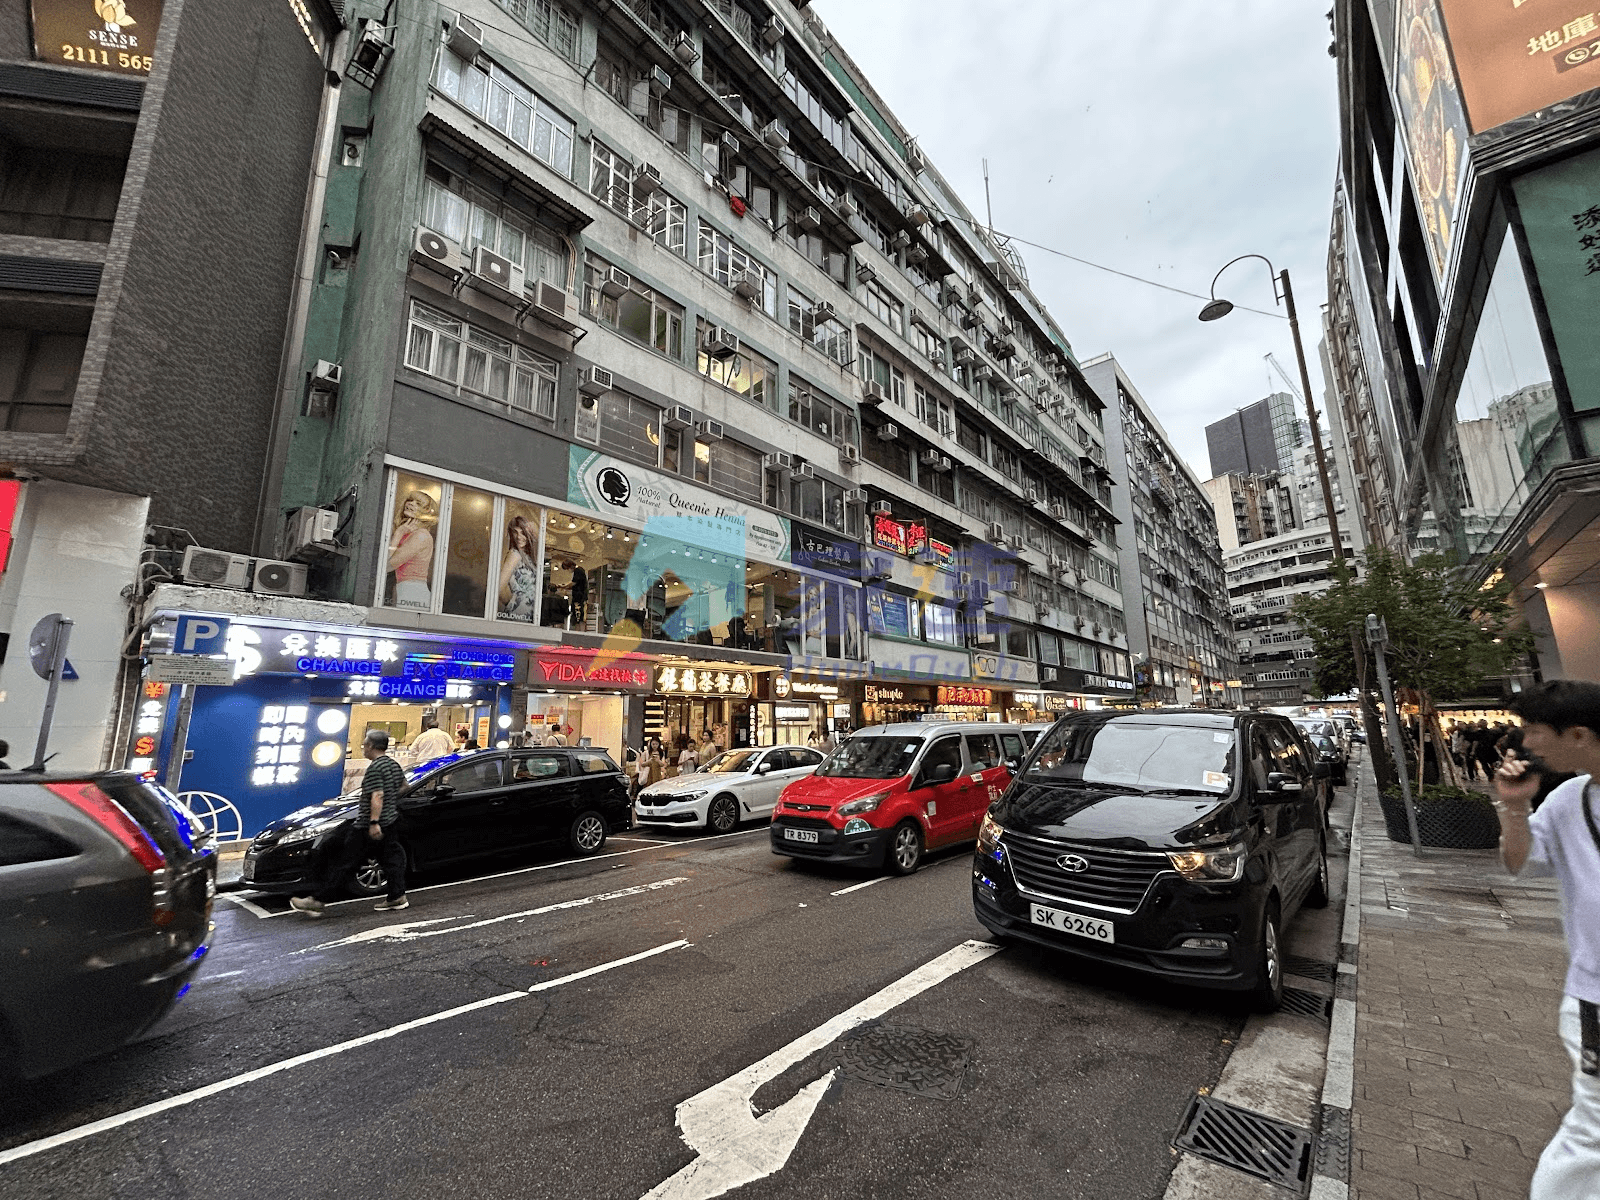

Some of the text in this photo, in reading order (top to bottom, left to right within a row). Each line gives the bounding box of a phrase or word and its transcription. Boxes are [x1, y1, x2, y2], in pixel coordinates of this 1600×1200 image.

[89, 29, 138, 47] SENSE
[1526, 11, 1600, 56] 地庫
[62, 44, 109, 65] 2111
[636, 496, 661, 509] Natural
[638, 486, 661, 501] 100%
[669, 492, 746, 528] Queenie Henna
[497, 611, 532, 622] GOLDWELL
[183, 619, 219, 650] P
[297, 657, 381, 674] CHANGE
[539, 661, 586, 682] YIDA
[380, 682, 446, 696] CHANGE
[657, 666, 747, 693] 銀龍茶餐廳
[786, 830, 817, 842] TR 8379
[1036, 909, 1108, 939] SK 6266
